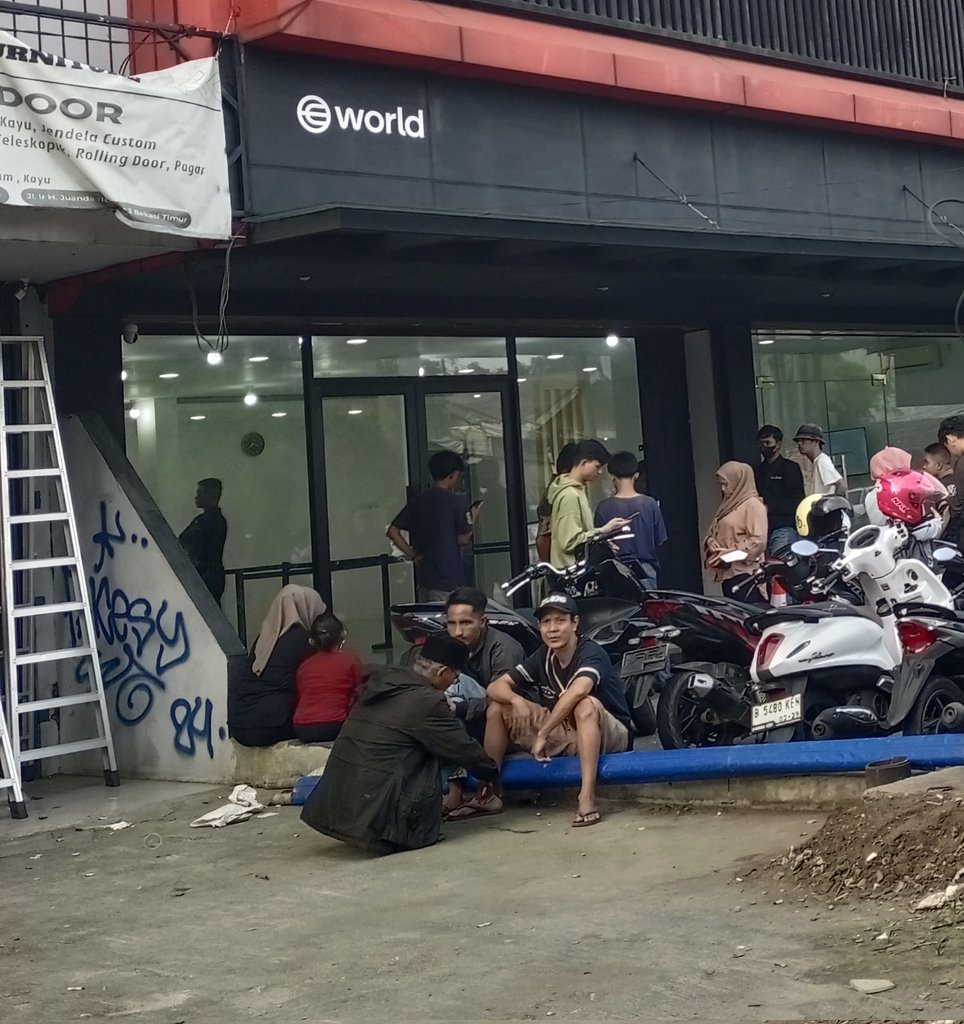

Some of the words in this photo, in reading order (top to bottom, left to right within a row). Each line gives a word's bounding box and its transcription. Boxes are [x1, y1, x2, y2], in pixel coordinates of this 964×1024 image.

[0, 86, 124, 125] DOOR
[335, 106, 425, 138] world
[103, 133, 157, 151] Custom
[76, 147, 128, 167] Rolling
[132, 155, 170, 172] Door,
[174, 160, 206, 176] Pagar
[23, 174, 51, 186] Kayu
[754, 708, 760, 718] B
